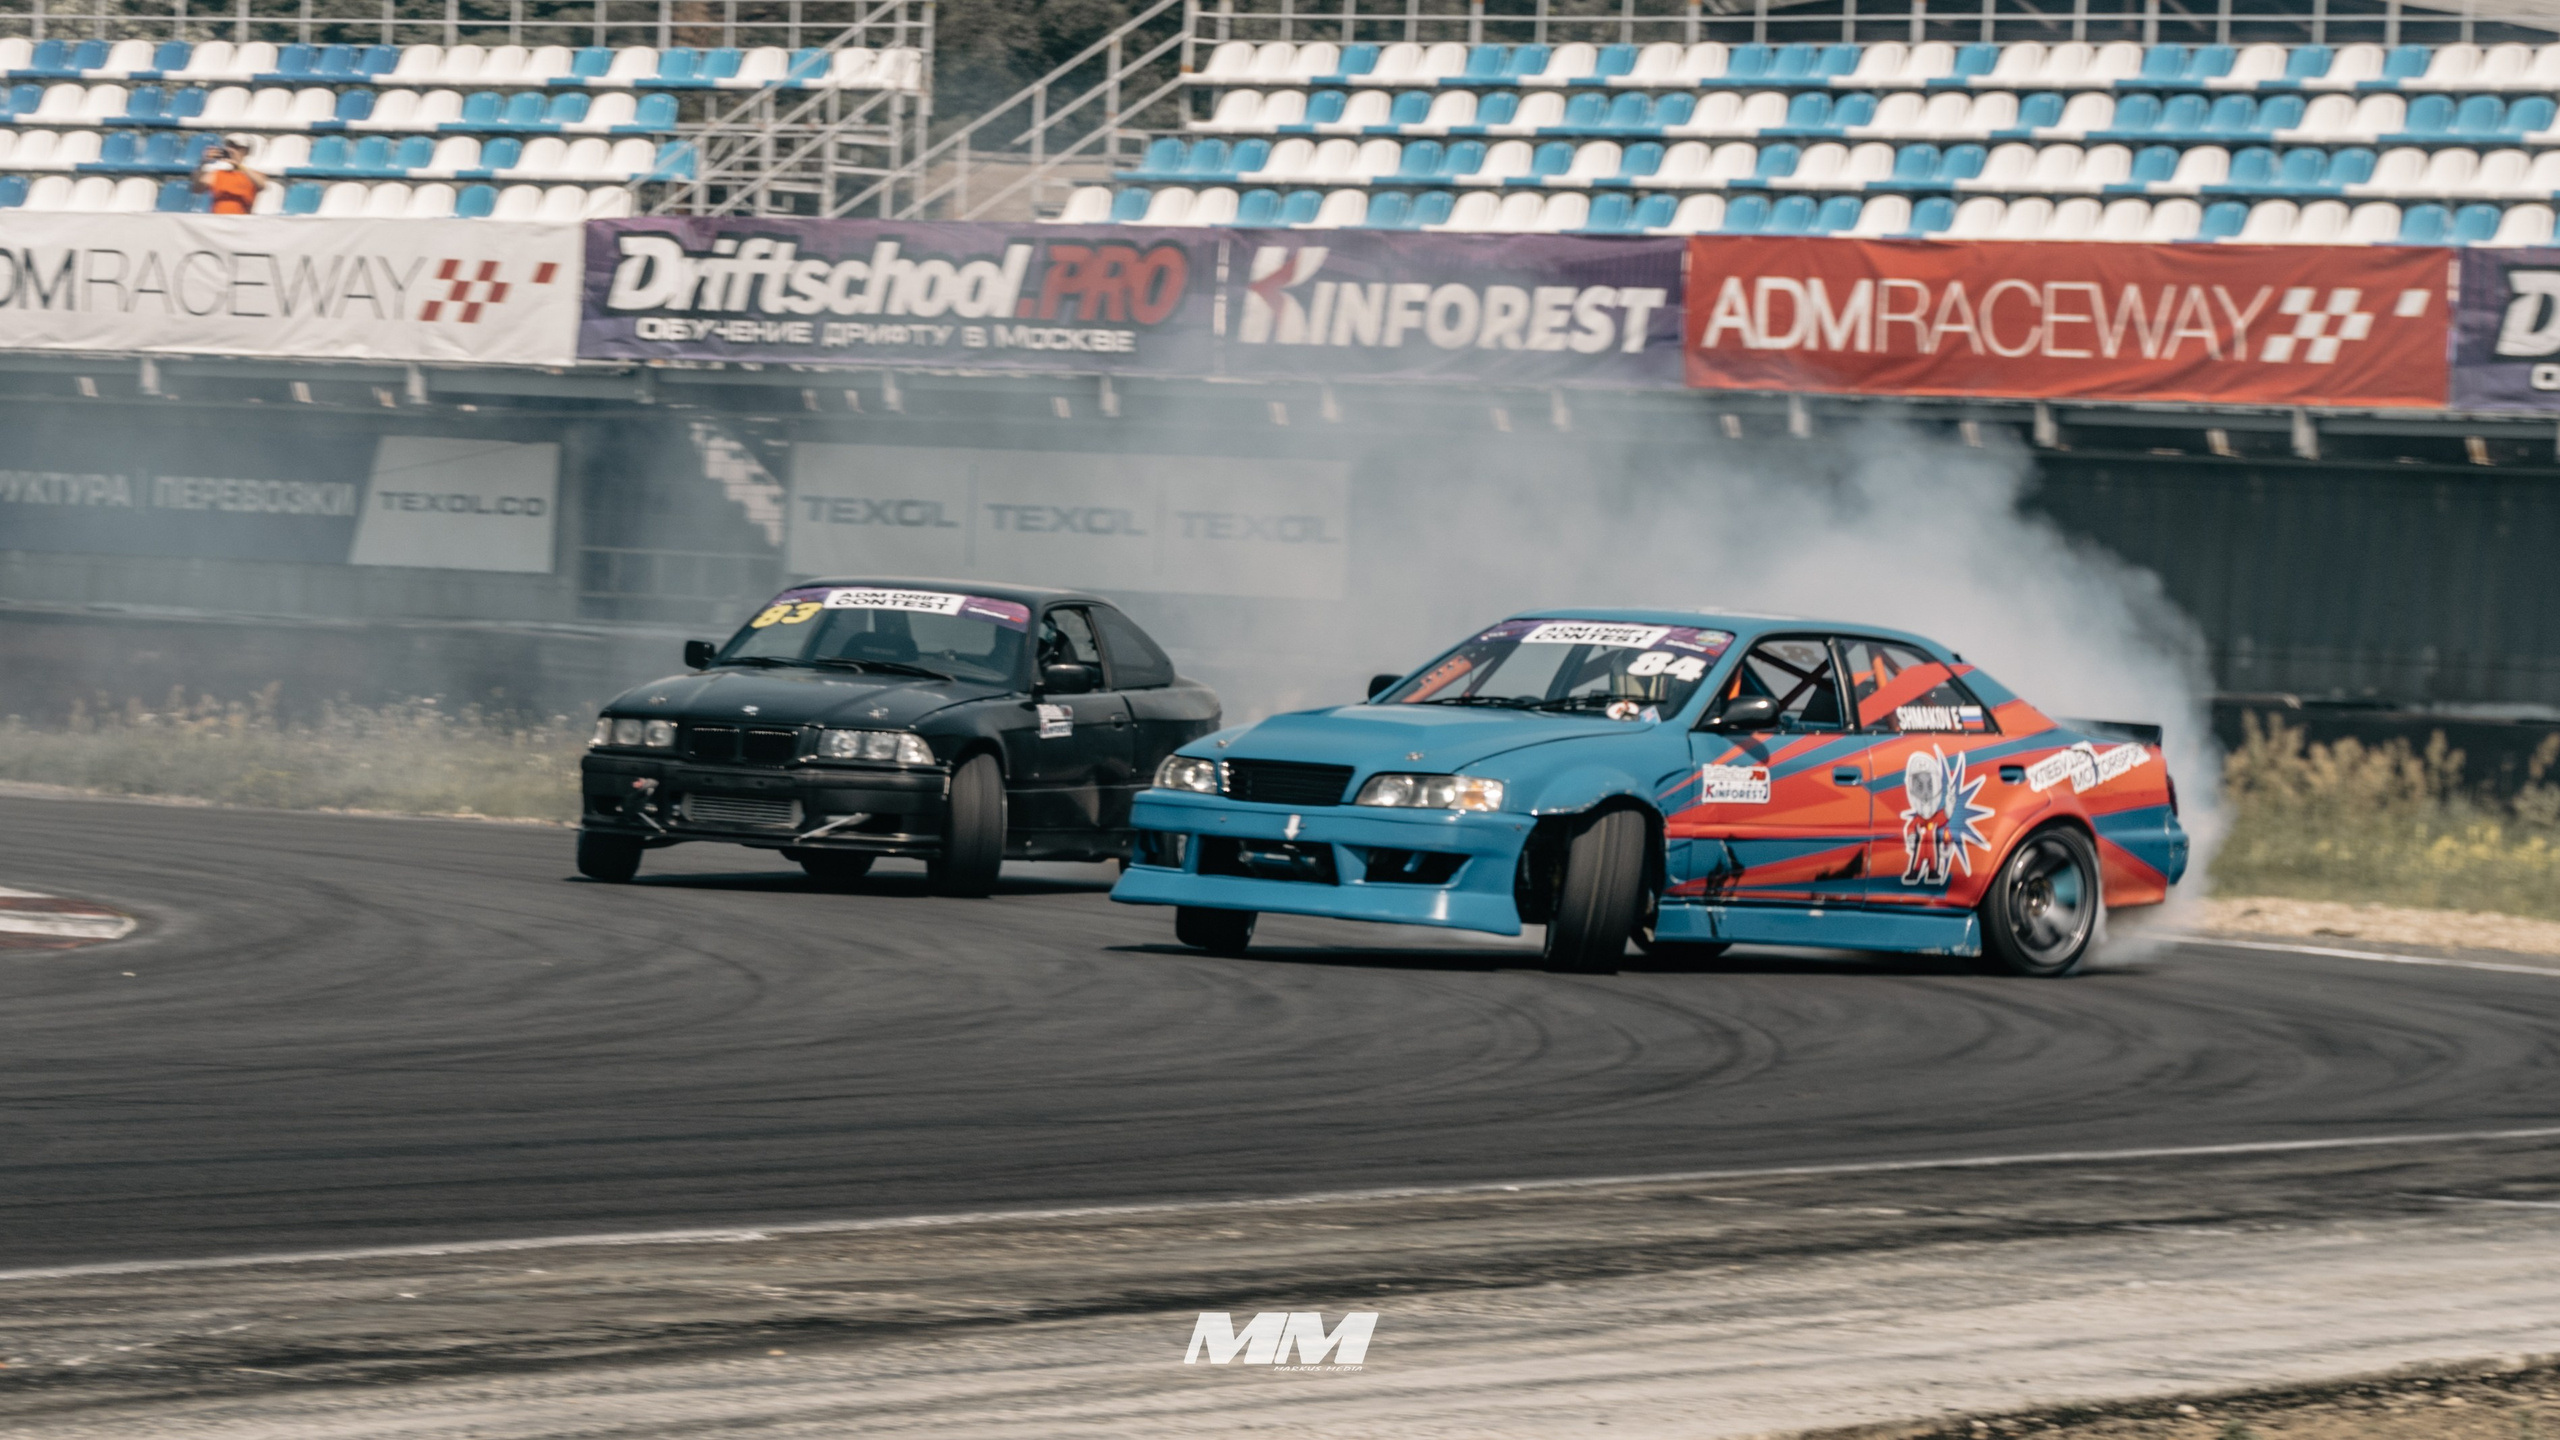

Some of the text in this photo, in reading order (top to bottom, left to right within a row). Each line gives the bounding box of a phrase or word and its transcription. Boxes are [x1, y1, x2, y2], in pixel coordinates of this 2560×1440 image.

[1238, 246, 1667, 354] KINFOREST
[635, 316, 814, 345] ОБУЧЕНИЕ
[820, 322, 948, 348] ДРИФТУ
[961, 327, 989, 349] В
[152, 475, 354, 515] ПЕРЕВОЗКИ
[803, 497, 960, 528] TEXOL
[986, 503, 1148, 537] TEXOL
[835, 598, 951, 611] CONTEST
[1534, 633, 1644, 645] CONTEST
[1627, 651, 1707, 683] 84
